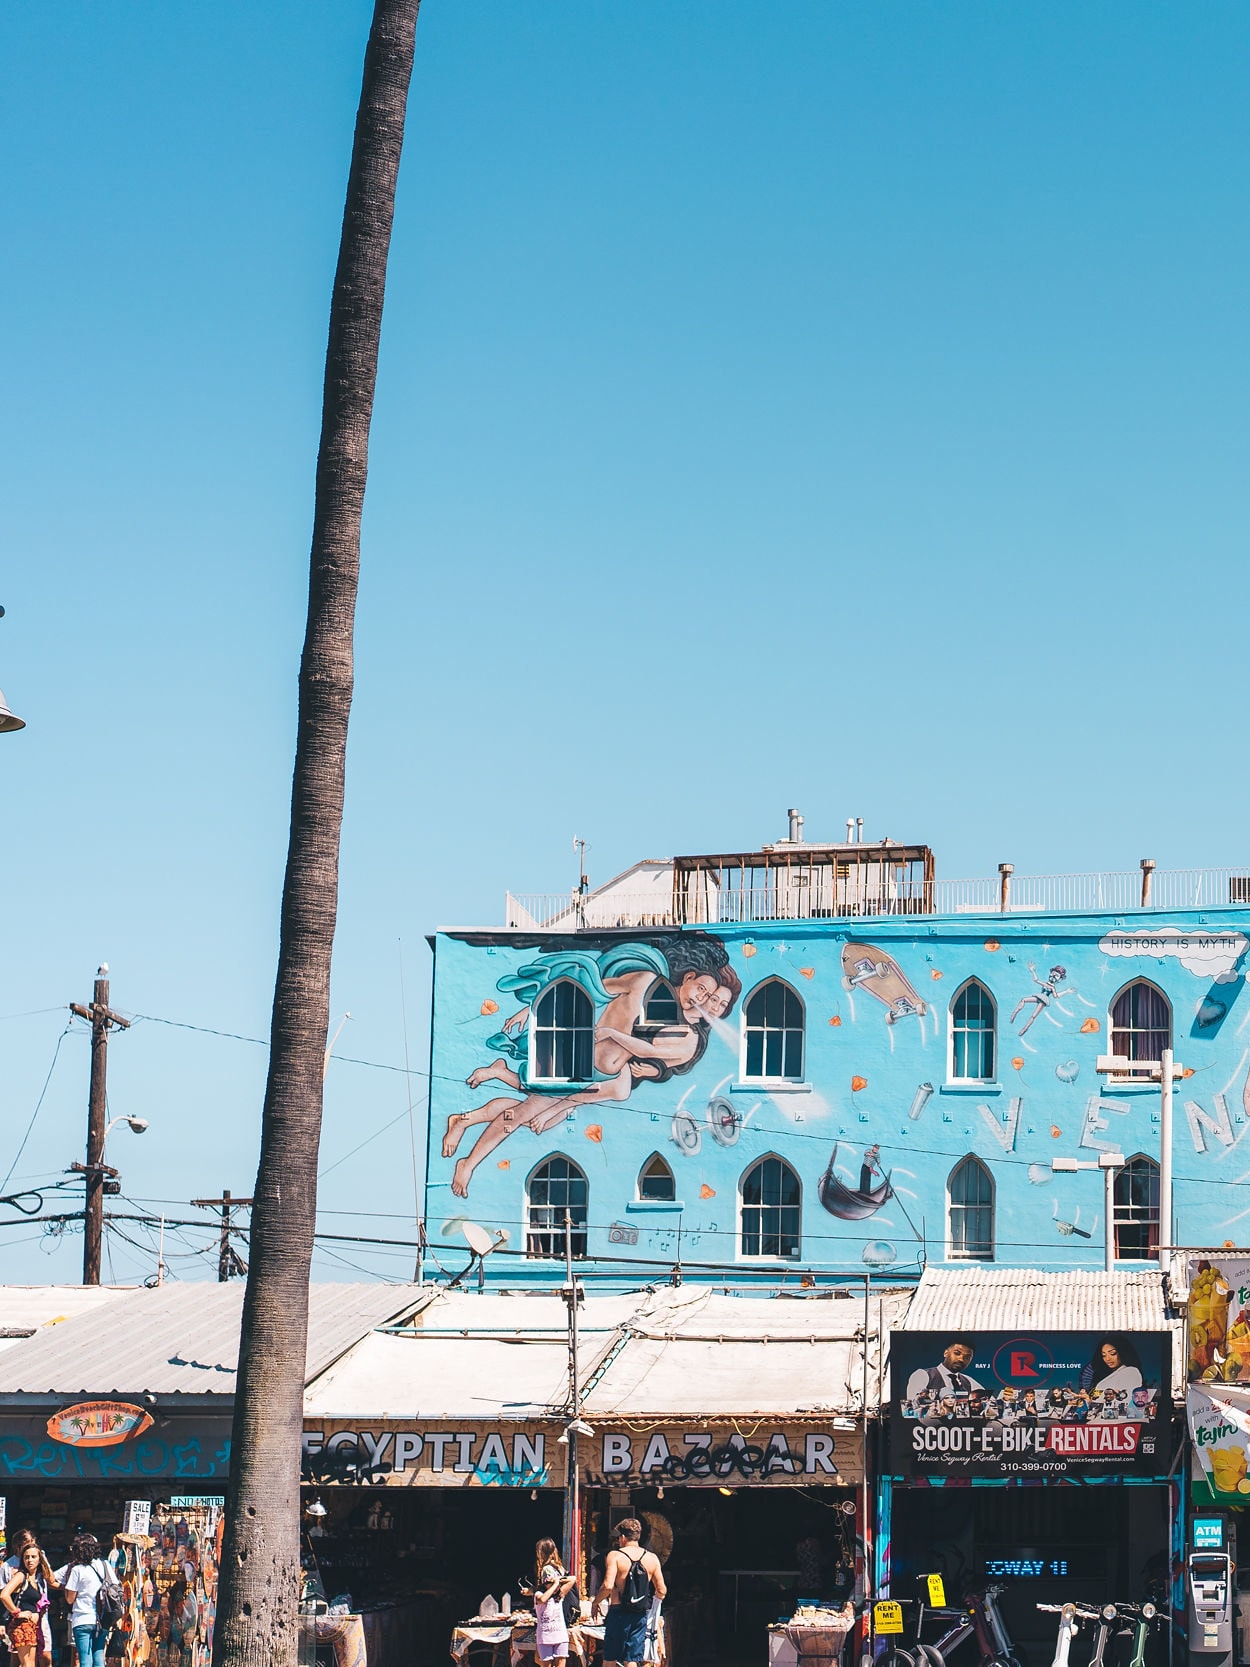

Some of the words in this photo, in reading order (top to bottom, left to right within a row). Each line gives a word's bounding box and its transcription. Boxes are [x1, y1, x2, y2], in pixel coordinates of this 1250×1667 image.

[1111, 938, 1167, 949] HISTORY
[1176, 938, 1189, 949] IS
[1199, 938, 1236, 949] MYTH
[912, 1425, 1047, 1452] SCOOT-E-BIKE
[1051, 1426, 1136, 1452] RENTALS
[602, 1433, 838, 1474] BAZAAR
[917, 1452, 939, 1463] Venice
[941, 1452, 971, 1466] Segway
[972, 1452, 1003, 1463] Rental
[1000, 1462, 1067, 1471] 310-399-0700
[133, 1503, 150, 1513] SALE
[1195, 1526, 1222, 1536] ATM
[876, 1604, 899, 1612] RENT
